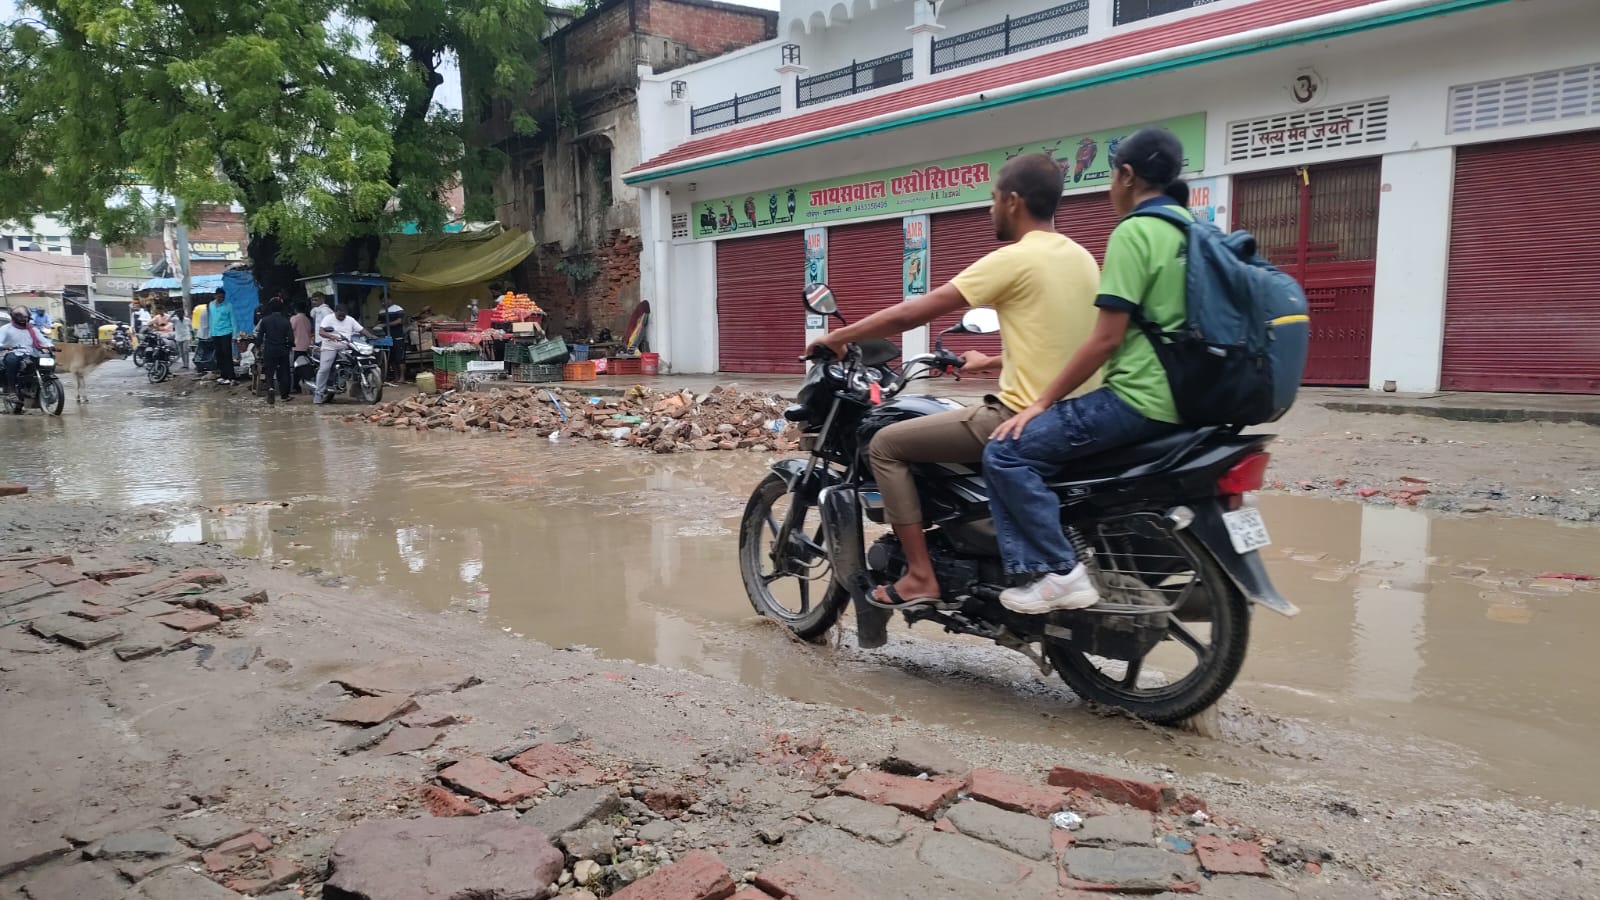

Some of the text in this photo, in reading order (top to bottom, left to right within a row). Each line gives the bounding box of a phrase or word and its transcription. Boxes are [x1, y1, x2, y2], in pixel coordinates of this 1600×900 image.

[1258, 130, 1286, 145] सत्य
[809, 162, 991, 207] जायसवाल एसोसिएट्स
[1189, 186, 1210, 207] MR
[906, 221, 923, 238] AMR
